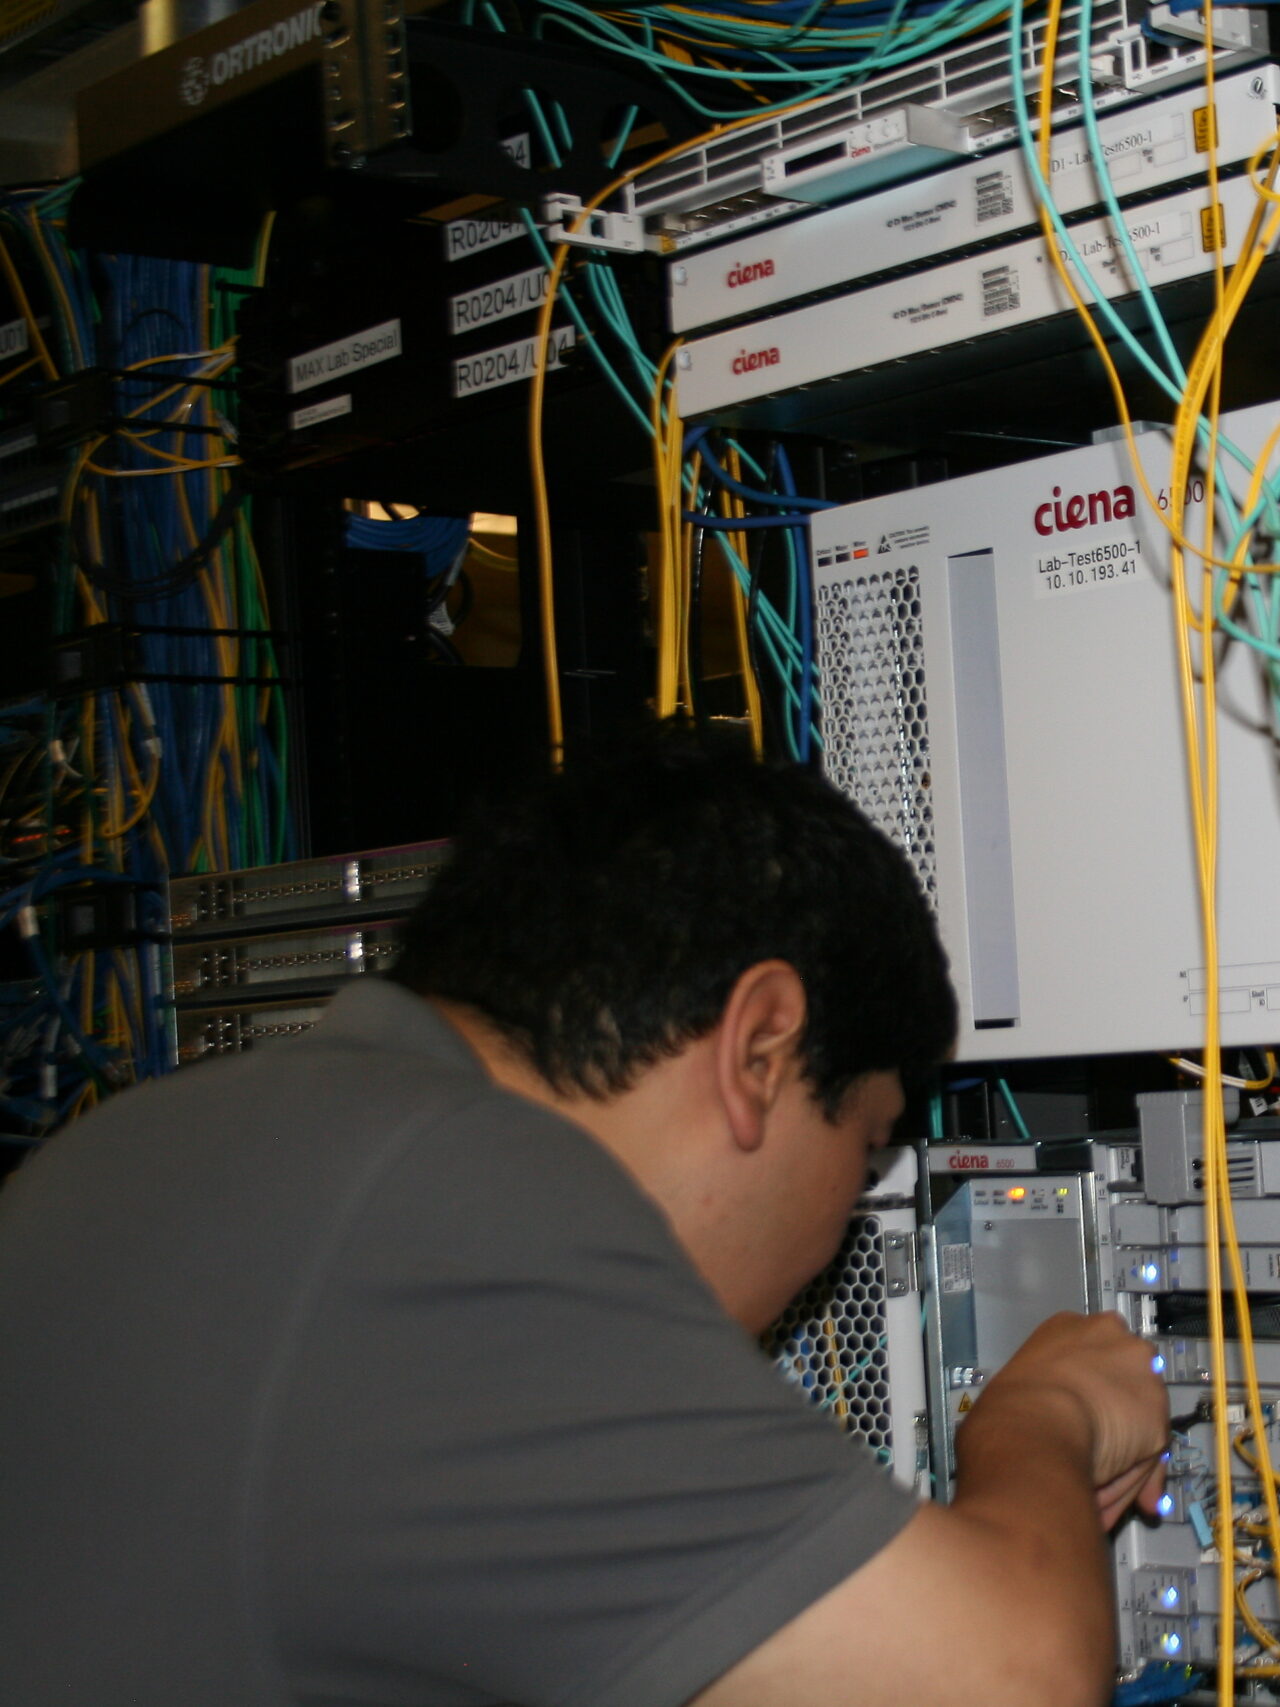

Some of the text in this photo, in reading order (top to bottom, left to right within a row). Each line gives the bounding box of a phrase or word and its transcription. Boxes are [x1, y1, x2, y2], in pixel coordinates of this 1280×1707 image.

[727, 259, 775, 288] ciena
[328, 348, 350, 372] Lab
[353, 329, 398, 362] Special
[732, 347, 781, 375] ciena
[1034, 485, 1136, 536] ciena
[1039, 540, 1142, 573] Lab-Test6500-1
[948, 1150, 989, 1169] ciena
